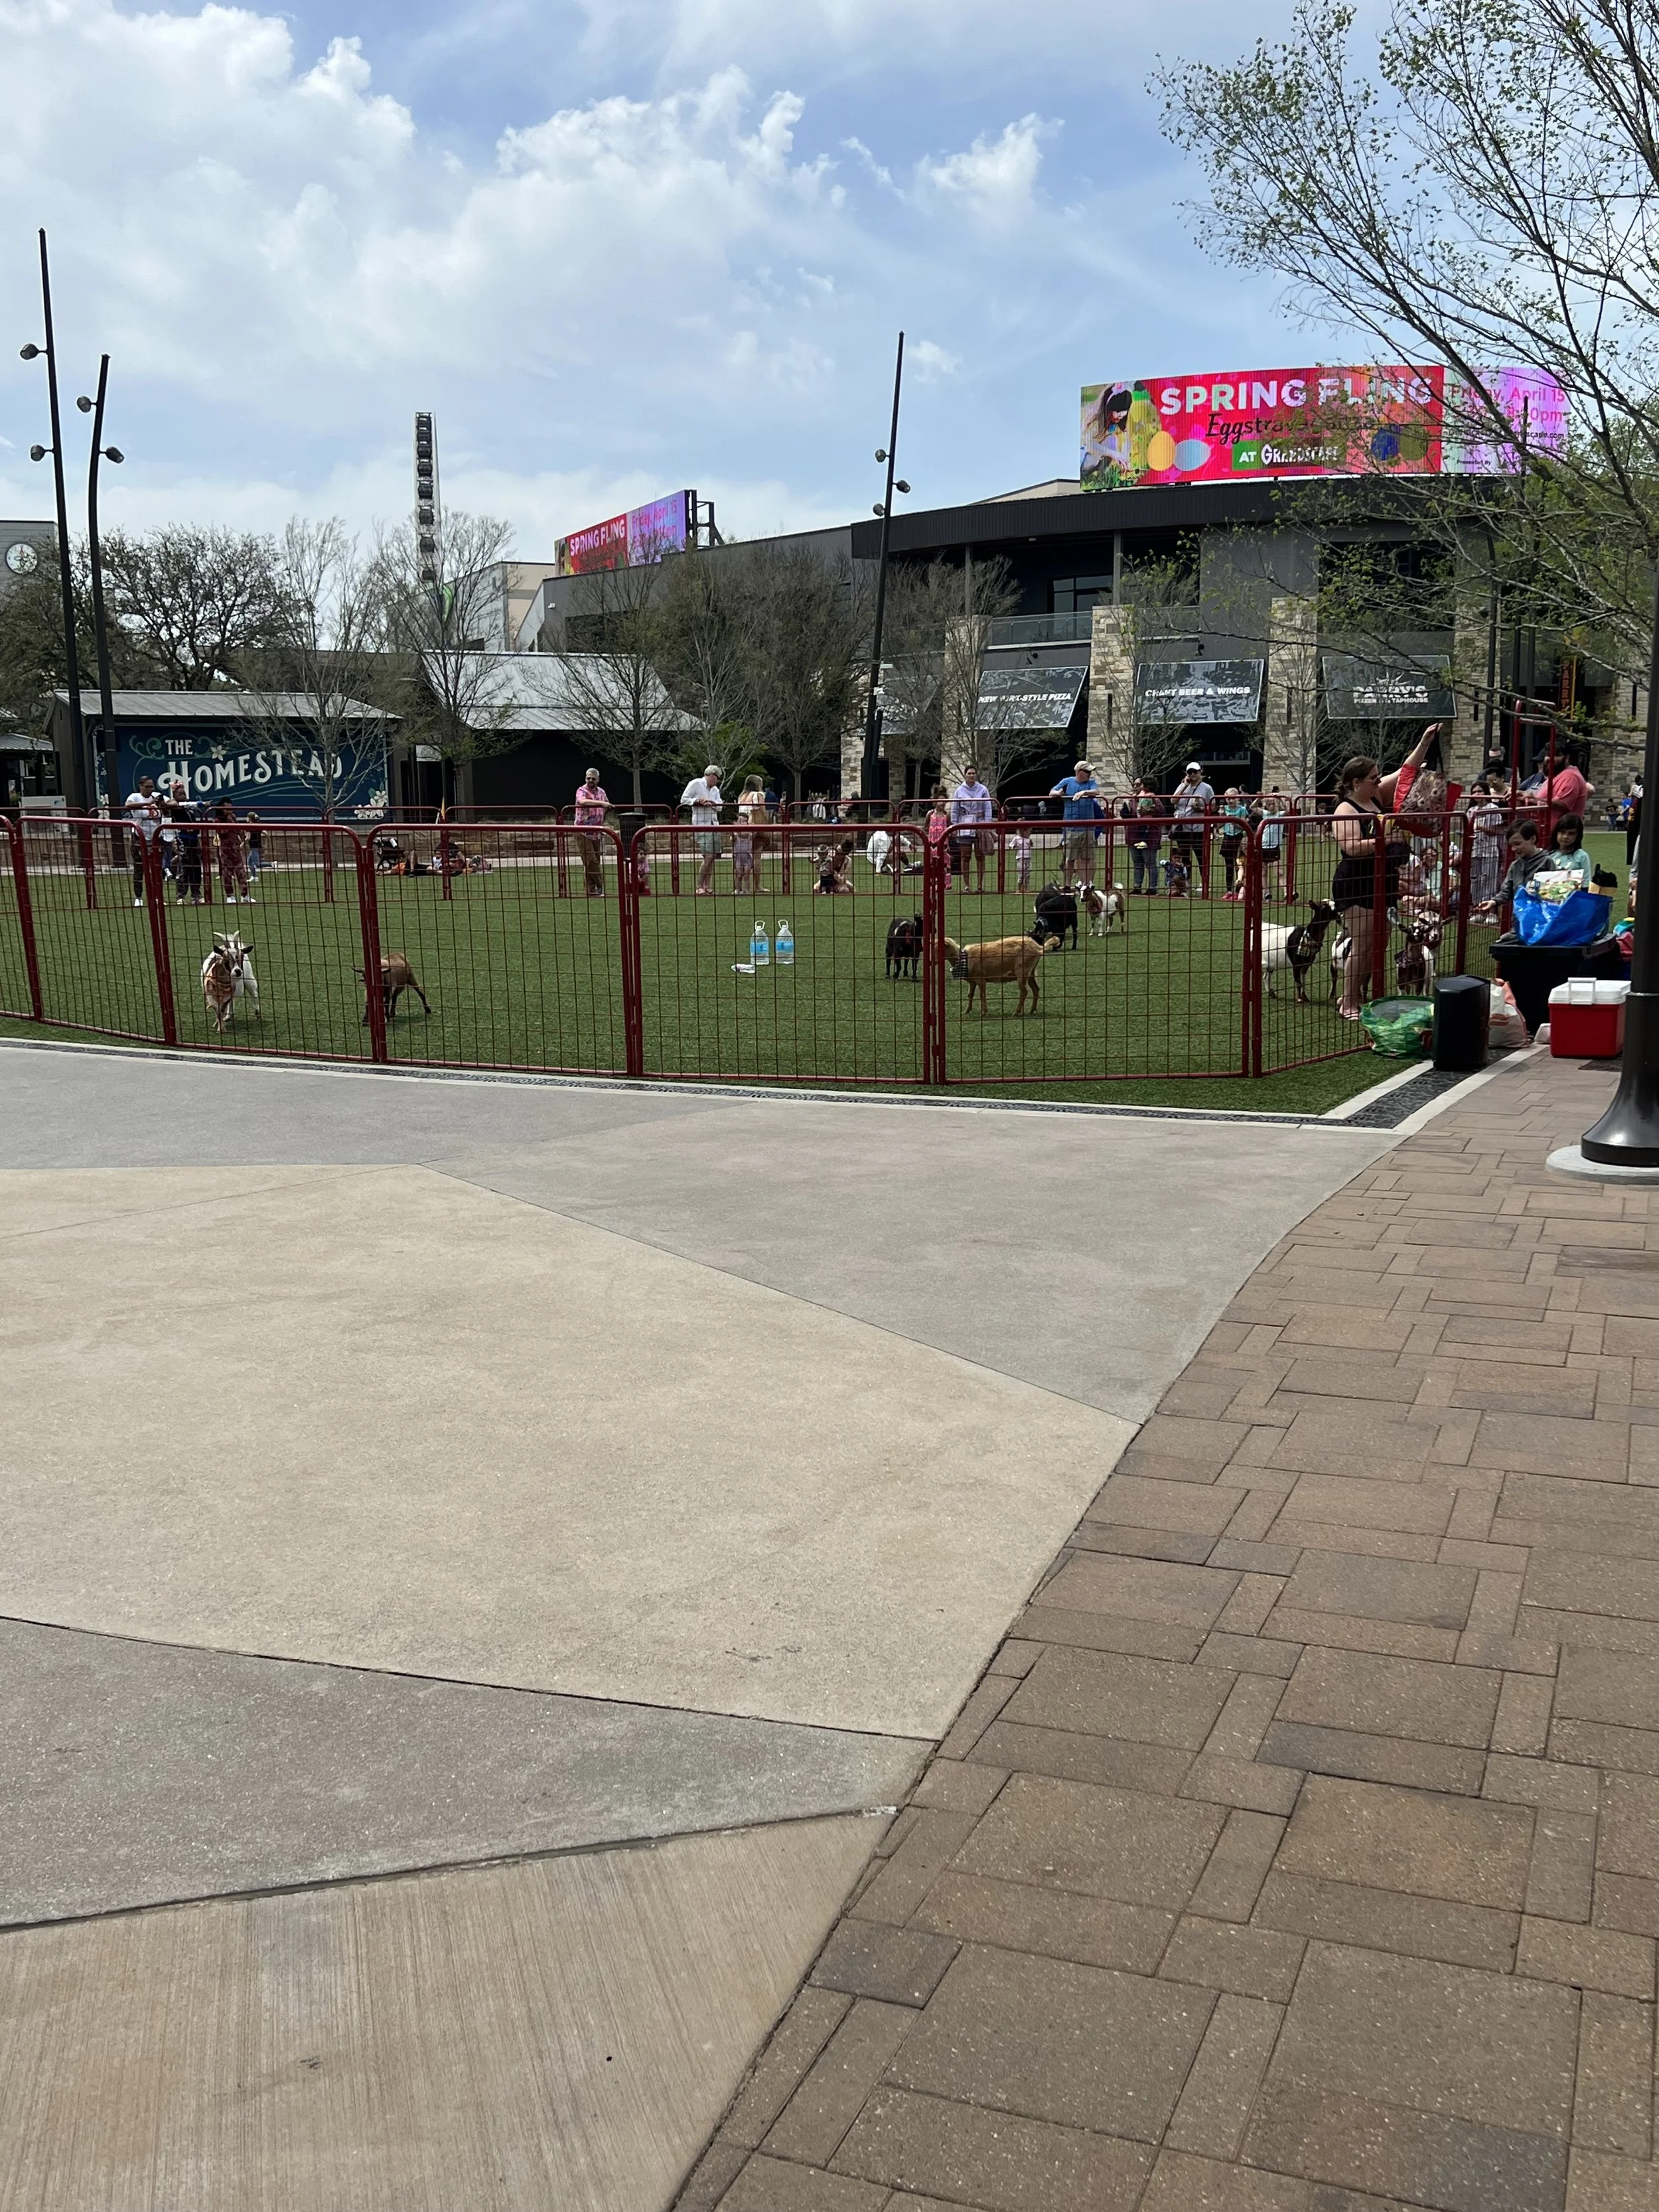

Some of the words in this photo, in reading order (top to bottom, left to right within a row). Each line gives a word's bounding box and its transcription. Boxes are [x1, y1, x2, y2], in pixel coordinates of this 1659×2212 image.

[1160, 379, 1307, 415] SPRING
[1318, 377, 1432, 406] FLING
[1510, 387, 1547, 401] April
[1552, 389, 1565, 402] 15
[1239, 451, 1258, 463] AT
[569, 529, 599, 557] SPRING
[601, 520, 625, 546] FLING
[165, 739, 193, 755] THE
[157, 749, 342, 800] HOMESTEAD
